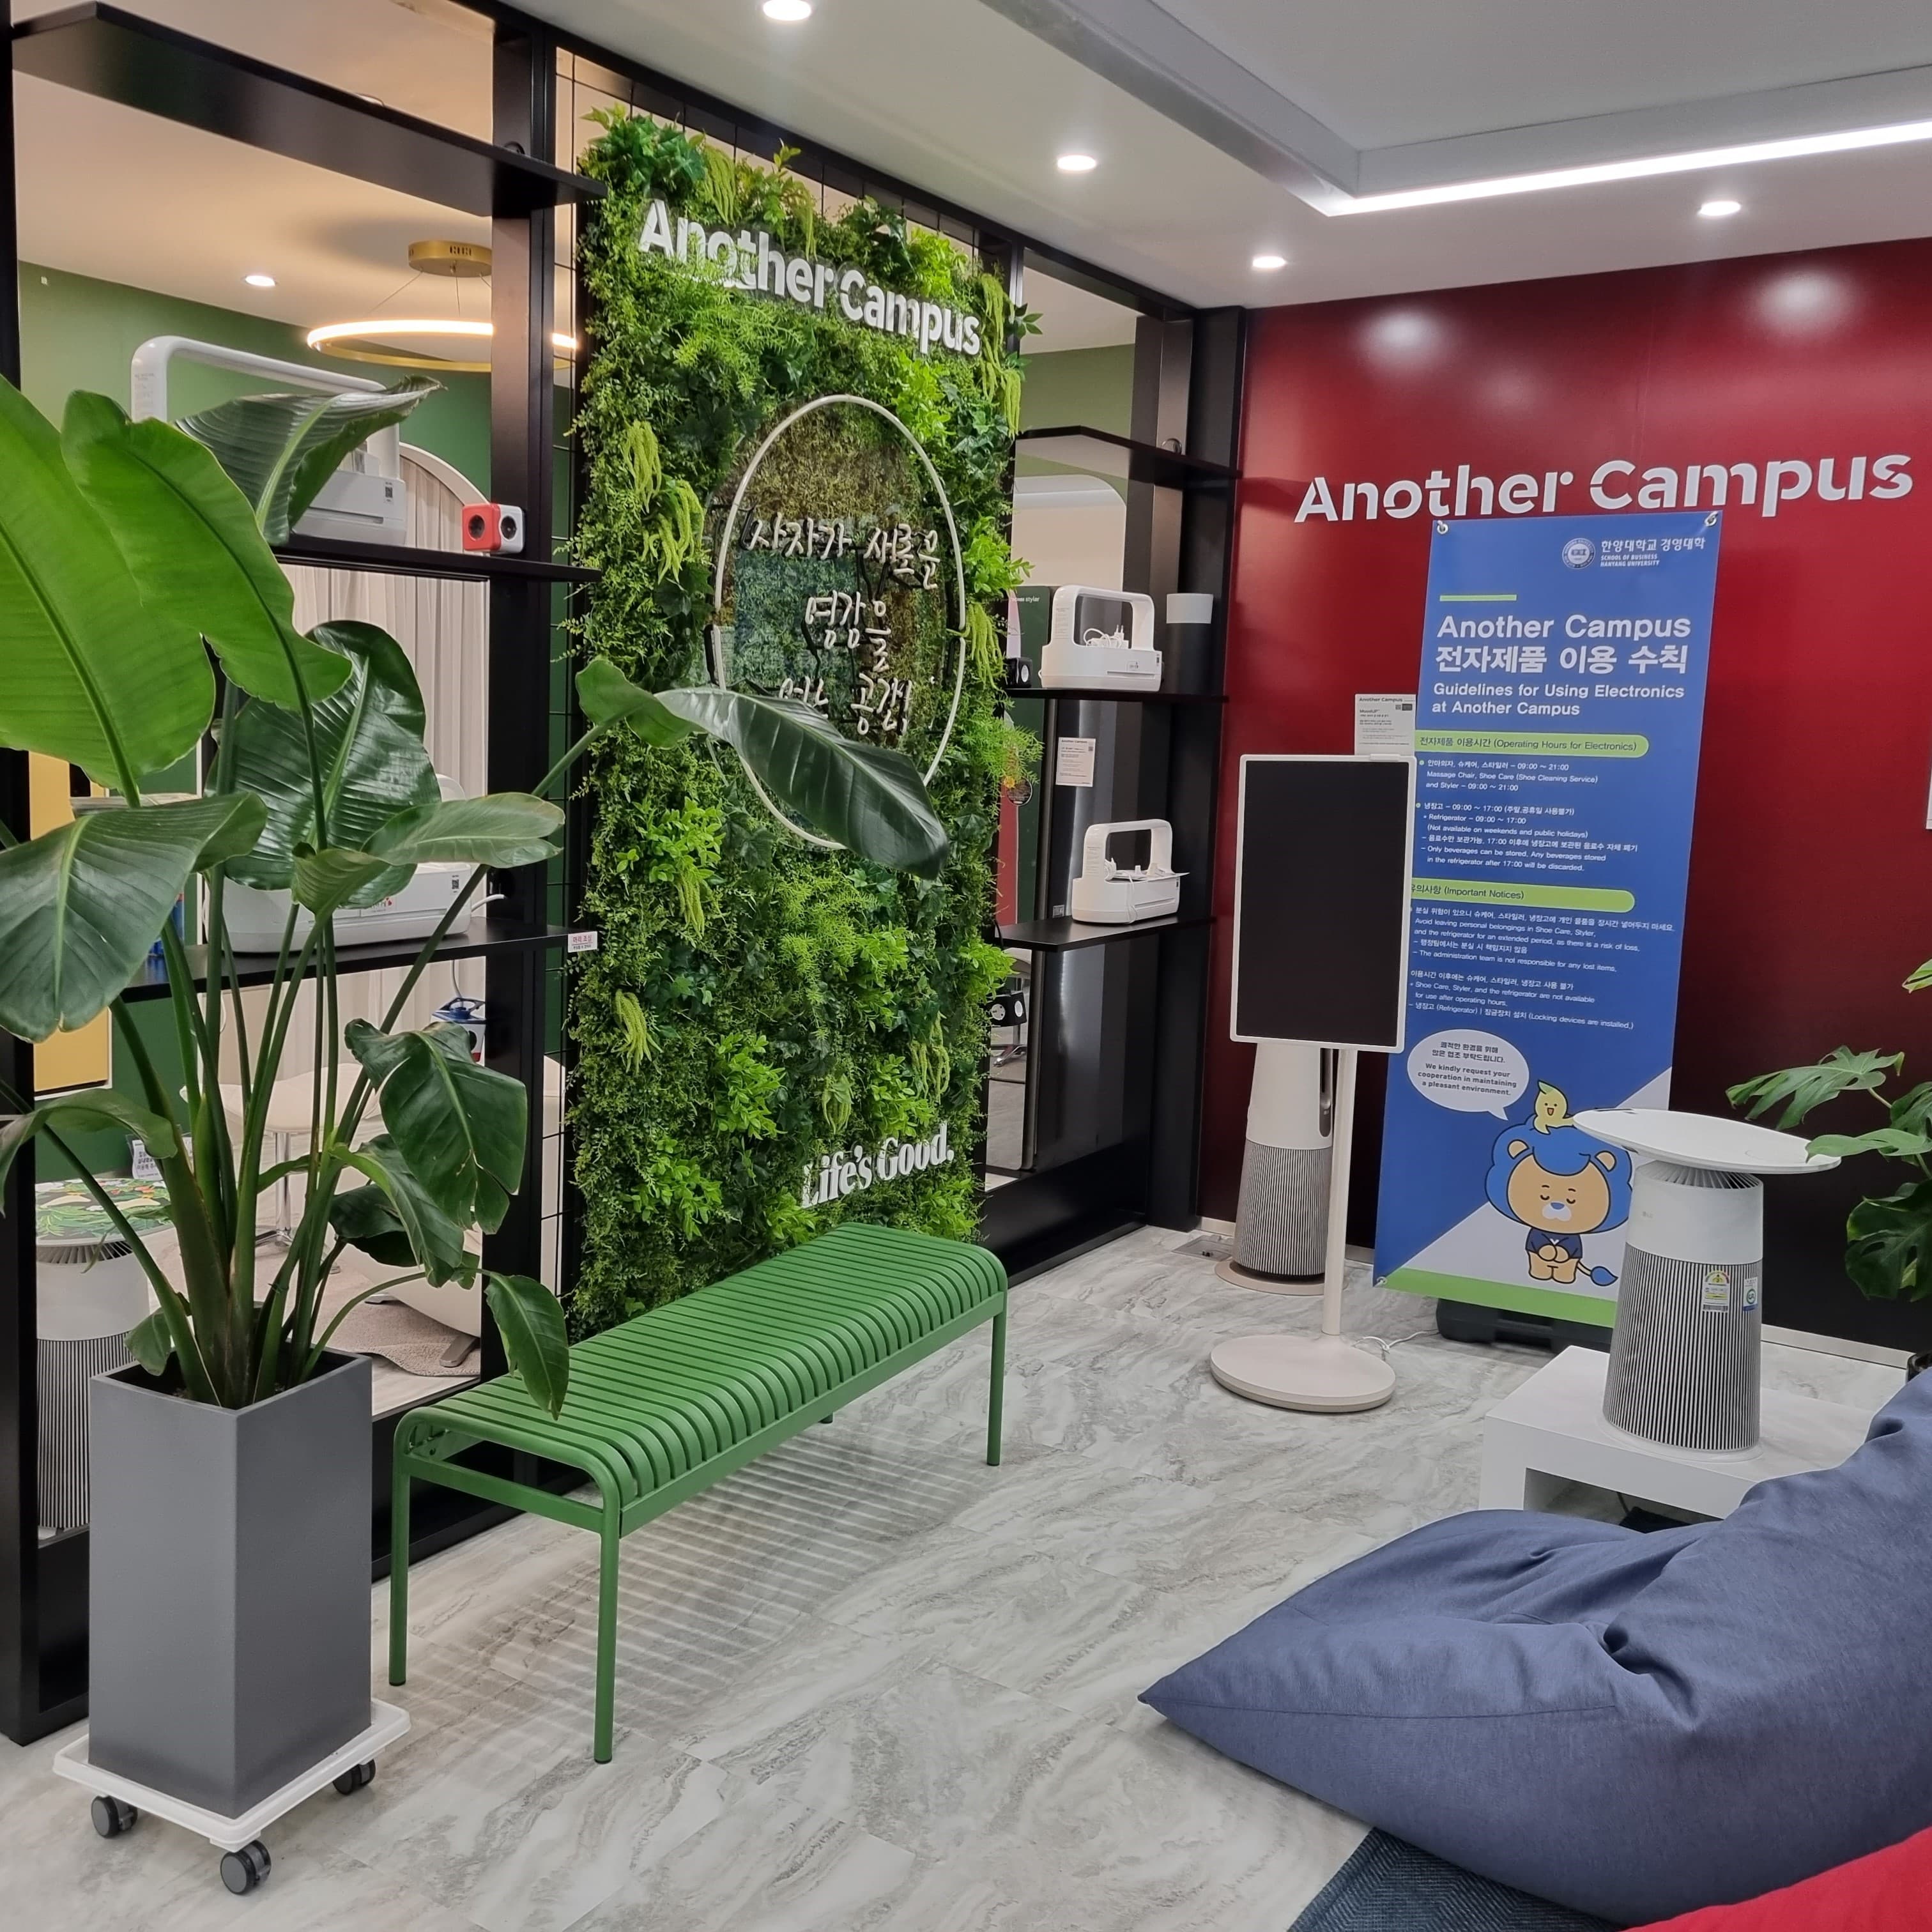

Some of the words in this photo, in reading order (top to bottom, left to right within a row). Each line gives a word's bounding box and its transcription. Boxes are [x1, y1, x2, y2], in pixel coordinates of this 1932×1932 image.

[639, 199, 833, 308] Another
[840, 270, 981, 356] Campus
[1294, 464, 1574, 523] Another
[1590, 454, 1913, 518] Campus
[747, 512, 852, 560] 사자가
[866, 523, 941, 590] 새로운
[1601, 539, 1657, 553] 한양대학교
[1660, 537, 1706, 551] 경영대학
[805, 590, 892, 673] 영감을
[1438, 616, 1554, 640] Another
[1565, 615, 1691, 641] Campus
[1435, 645, 1547, 675] 전자제품
[1560, 645, 1617, 673] 이용
[1629, 644, 1687, 675] 수칙
[1433, 682, 1514, 698] Guidelines
[1517, 683, 1539, 698] for
[1544, 684, 1588, 700] Using
[1594, 684, 1685, 698] Electronics
[1432, 702, 1446, 714] at
[1452, 700, 1513, 715] Another
[1517, 702, 1580, 717] Campus
[1420, 737, 1453, 746] 전자제품
[1457, 738, 1491, 747] 이용시간
[1494, 739, 1538, 749] (Operating
[1585, 742, 1636, 751] Electronics)
[1445, 886, 1486, 896] (Important
[1489, 890, 1524, 900] Notices)
[1418, 1071, 1462, 1082] cooperation
[1472, 1077, 1517, 1087] maintaining
[1438, 1064, 1461, 1073] kindly
[1462, 1068, 1491, 1077] request
[1428, 1081, 1460, 1090] pleasant
[1461, 1085, 1512, 1096] environment.
[876, 1121, 954, 1181] Good.
